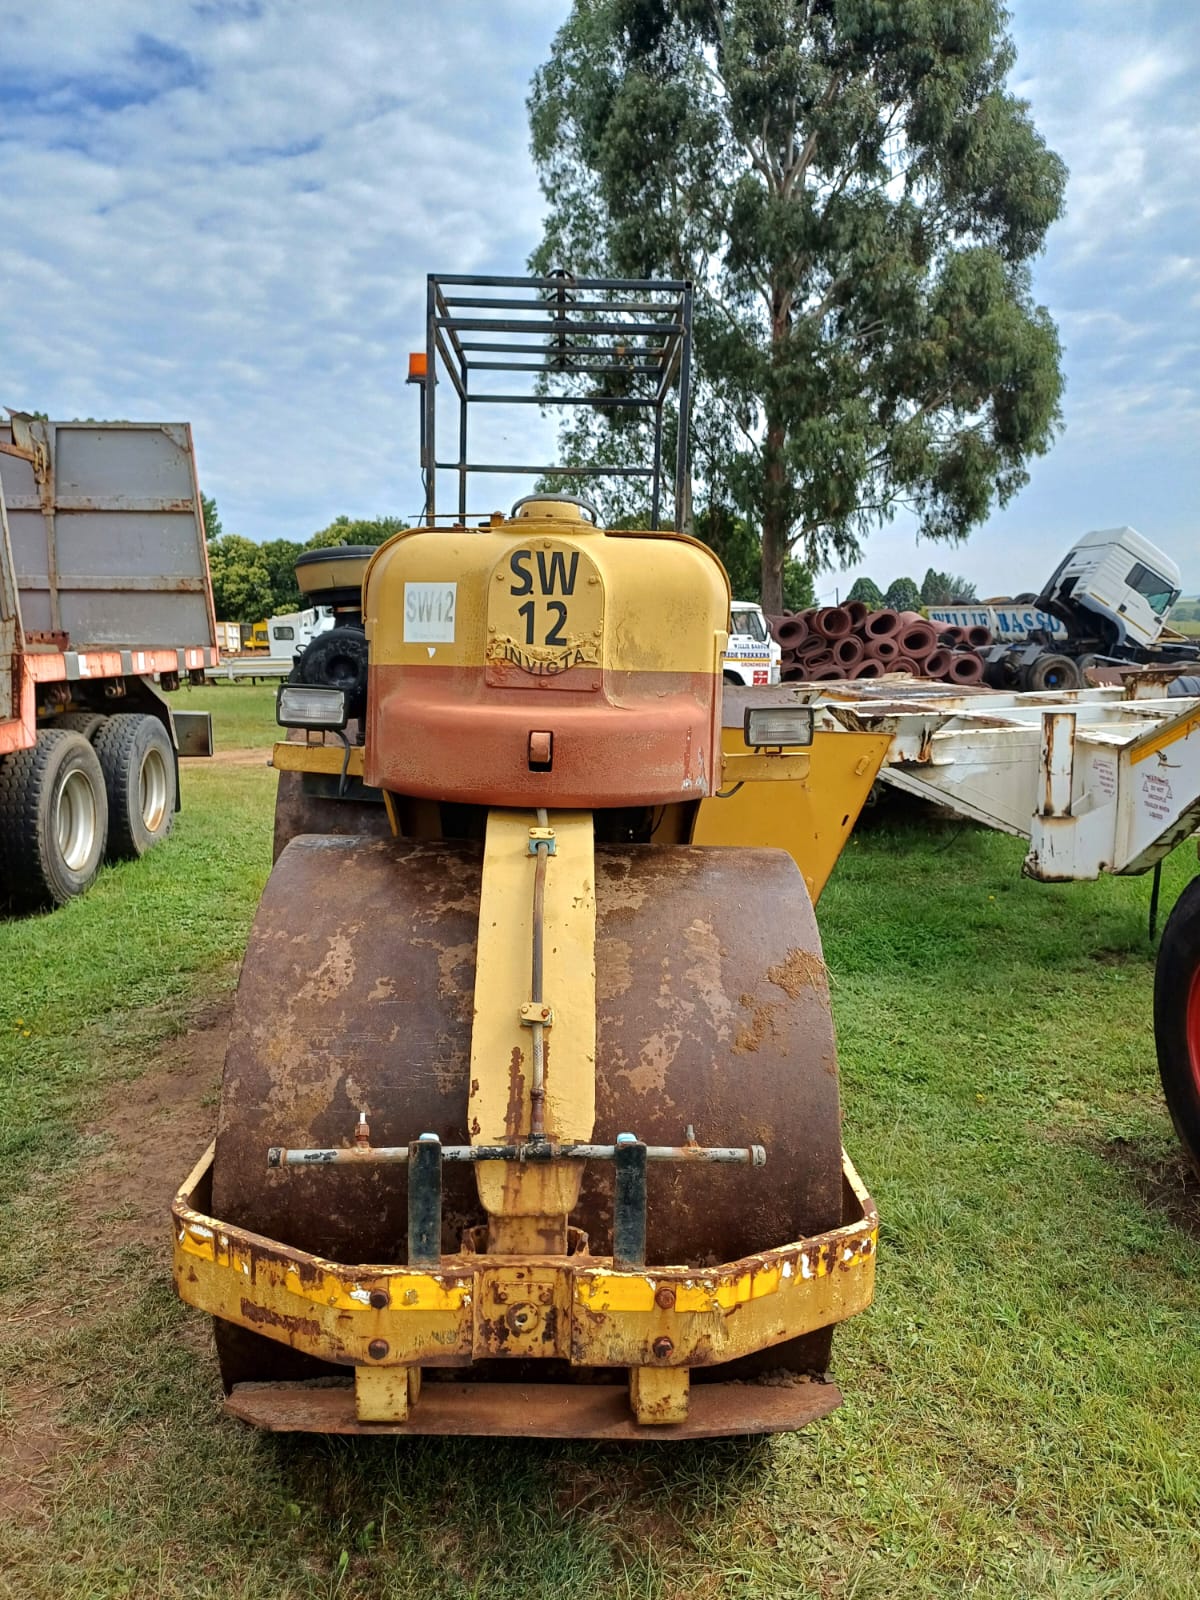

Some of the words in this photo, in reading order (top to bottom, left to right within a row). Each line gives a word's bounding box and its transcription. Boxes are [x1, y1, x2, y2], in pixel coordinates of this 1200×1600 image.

[510, 549, 579, 596] SW
[406, 590, 454, 623] SW12
[518, 600, 568, 647] 12
[503, 645, 585, 676] INVICTA
